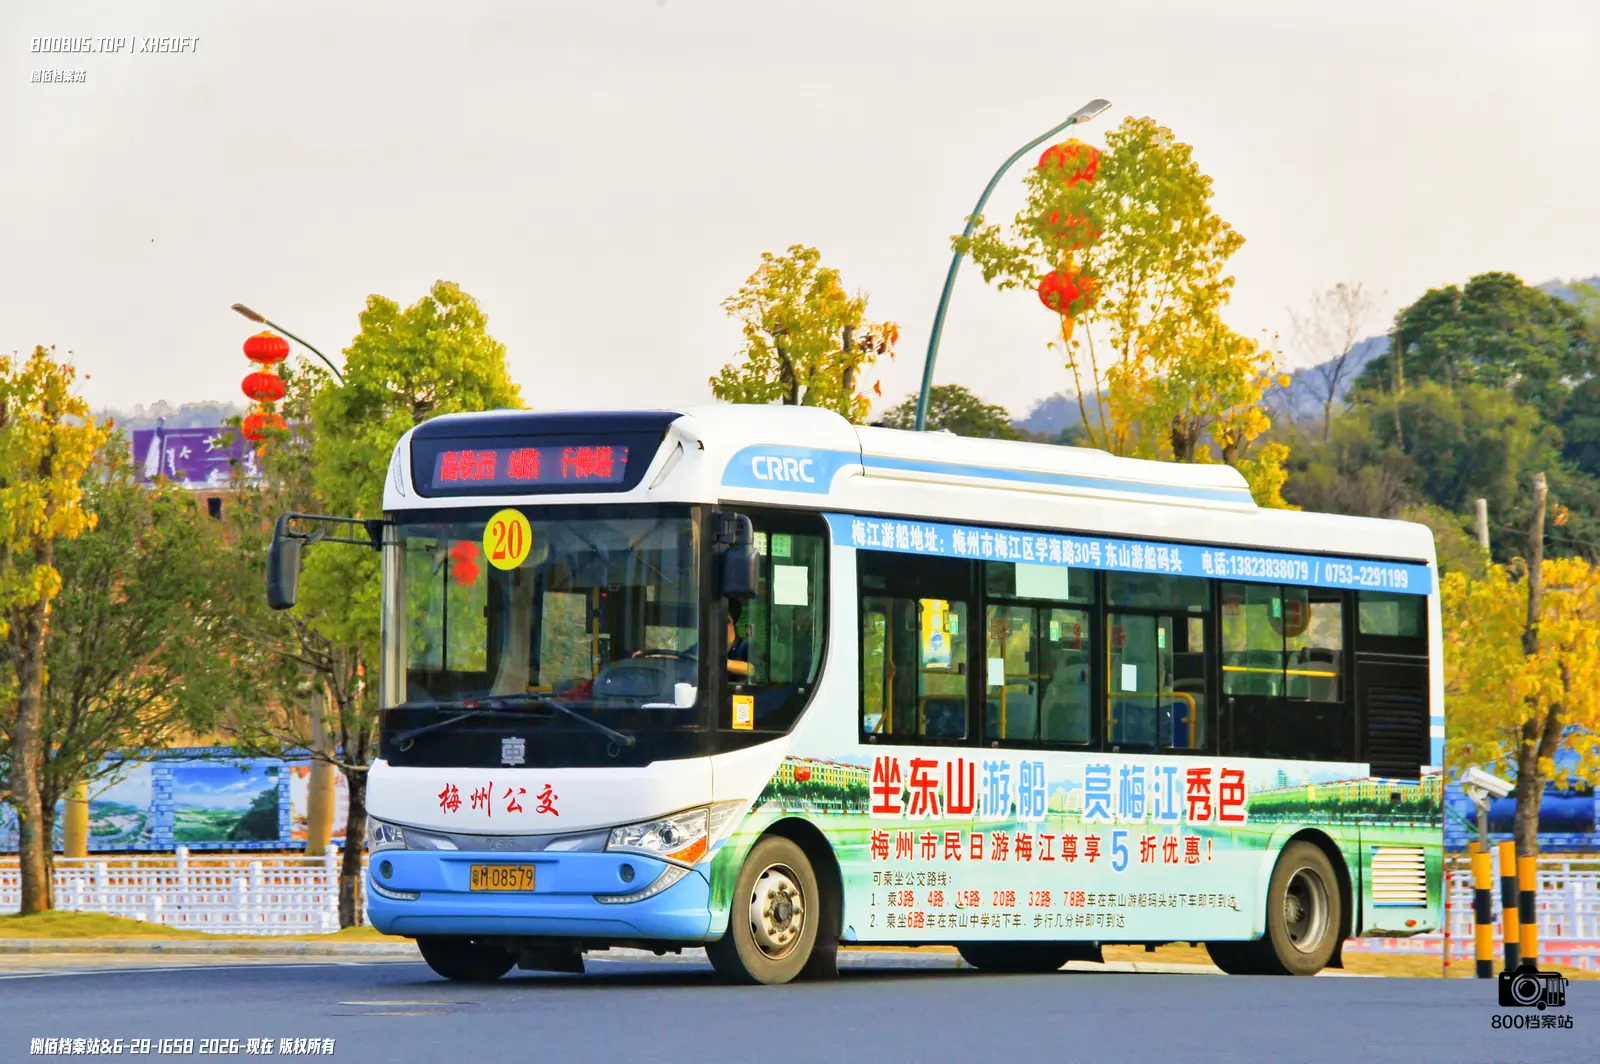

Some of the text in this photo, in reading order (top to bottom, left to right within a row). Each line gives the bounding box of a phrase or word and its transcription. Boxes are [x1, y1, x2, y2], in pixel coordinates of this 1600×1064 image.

[752, 456, 815, 483] CRRC
[492, 520, 523, 559] 20
[1105, 542, 1183, 572] 东山游船码头
[1325, 564, 1409, 589] 0753-2291199
[438, 782, 559, 817] 梅州公交
[872, 756, 1247, 822] 坐东山游船 赏梅江秀色
